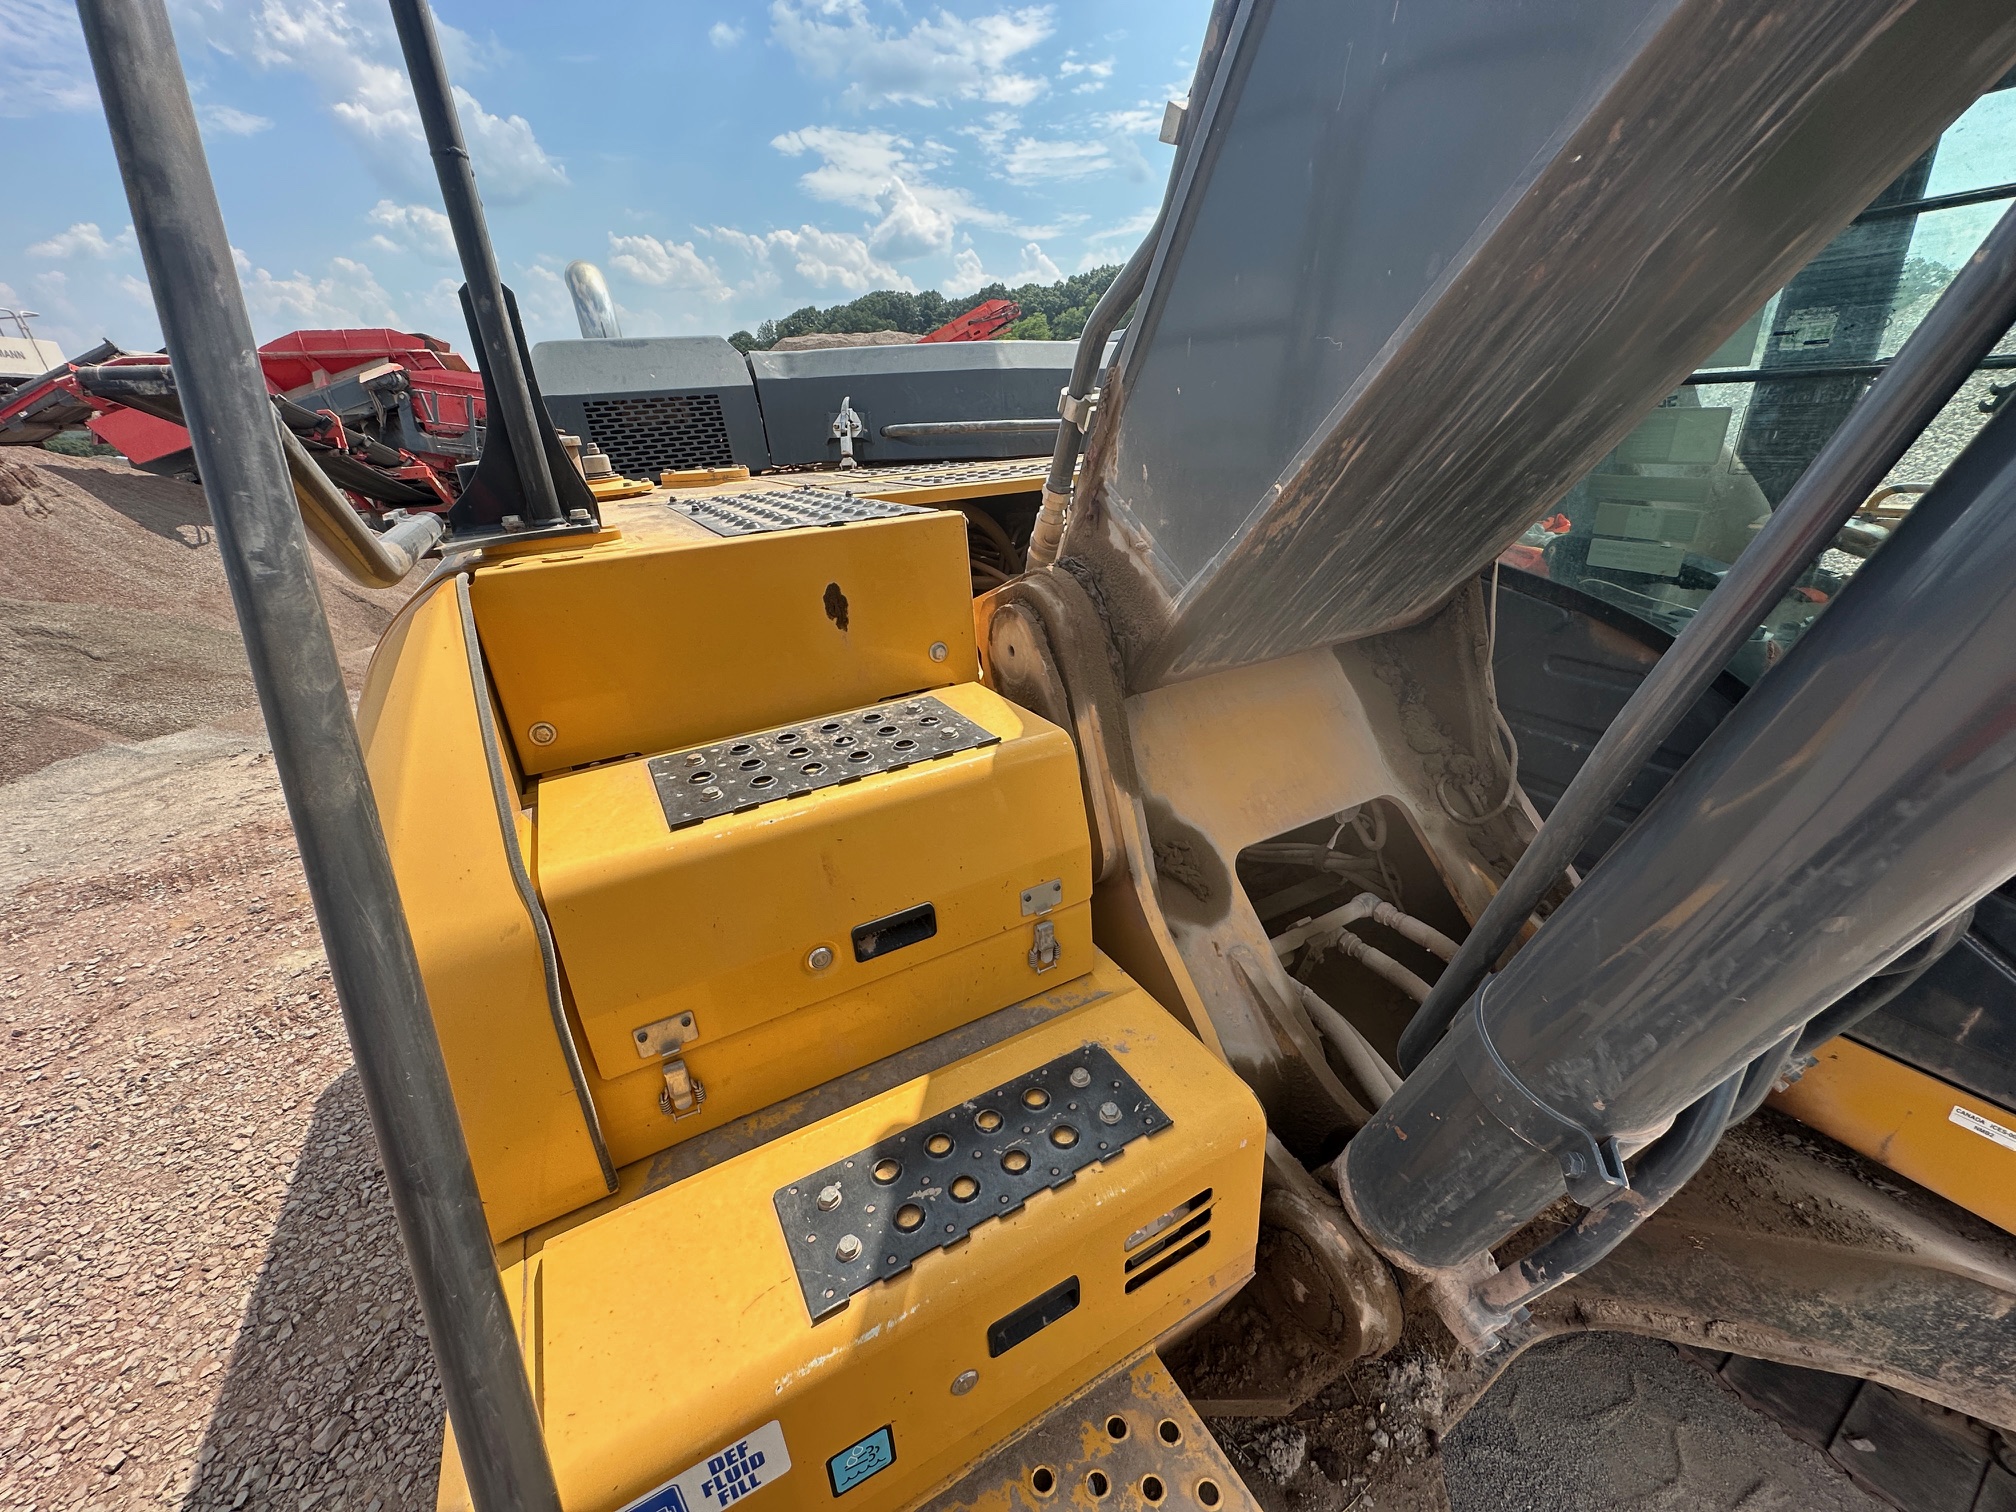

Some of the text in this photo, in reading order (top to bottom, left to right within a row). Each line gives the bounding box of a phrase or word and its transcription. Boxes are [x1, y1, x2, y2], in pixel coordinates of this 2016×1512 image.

[1955, 1108, 1985, 1125] CANADA
[701, 1451, 766, 1498] FLUID
[707, 1440, 748, 1476] DEF
[717, 1472, 761, 1507] FILL
